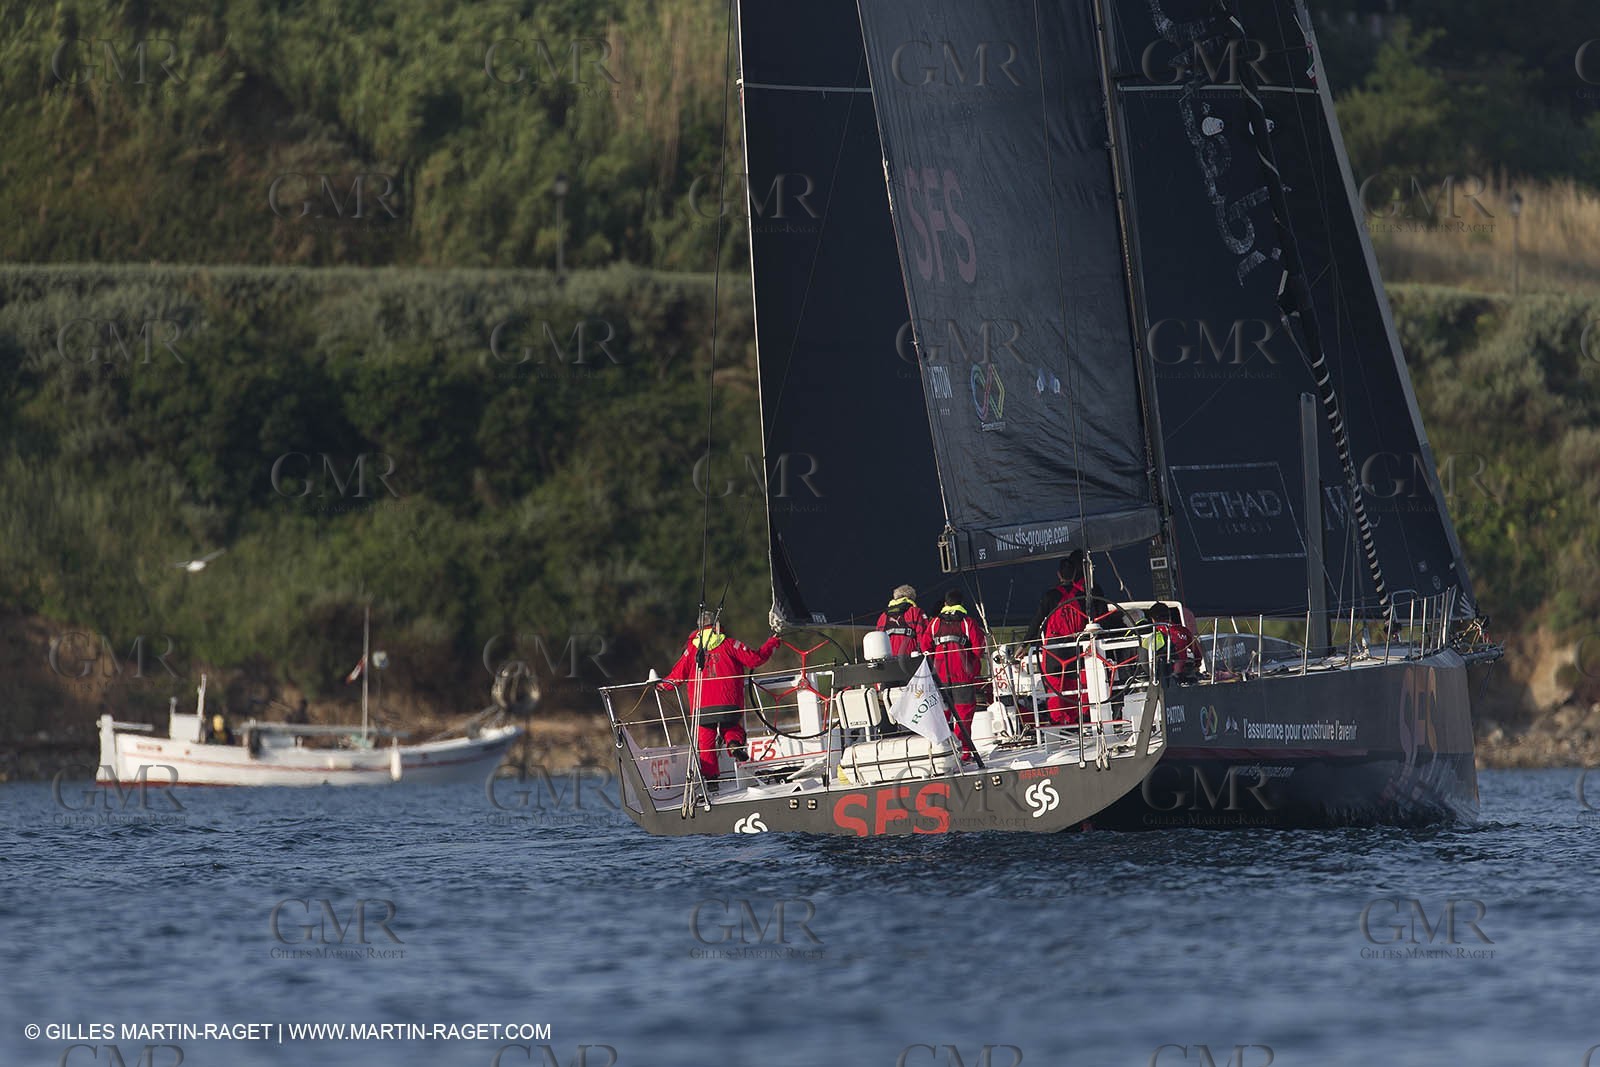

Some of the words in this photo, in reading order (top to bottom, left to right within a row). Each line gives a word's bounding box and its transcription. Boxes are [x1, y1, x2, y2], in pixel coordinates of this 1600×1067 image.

[905, 167, 977, 283] SFS
[1190, 489, 1282, 519] ETIHAD
[1243, 718, 1283, 740] l'assurance
[1284, 724, 1301, 745] pour
[1302, 719, 1335, 740] construire
[833, 782, 950, 837] SFS
